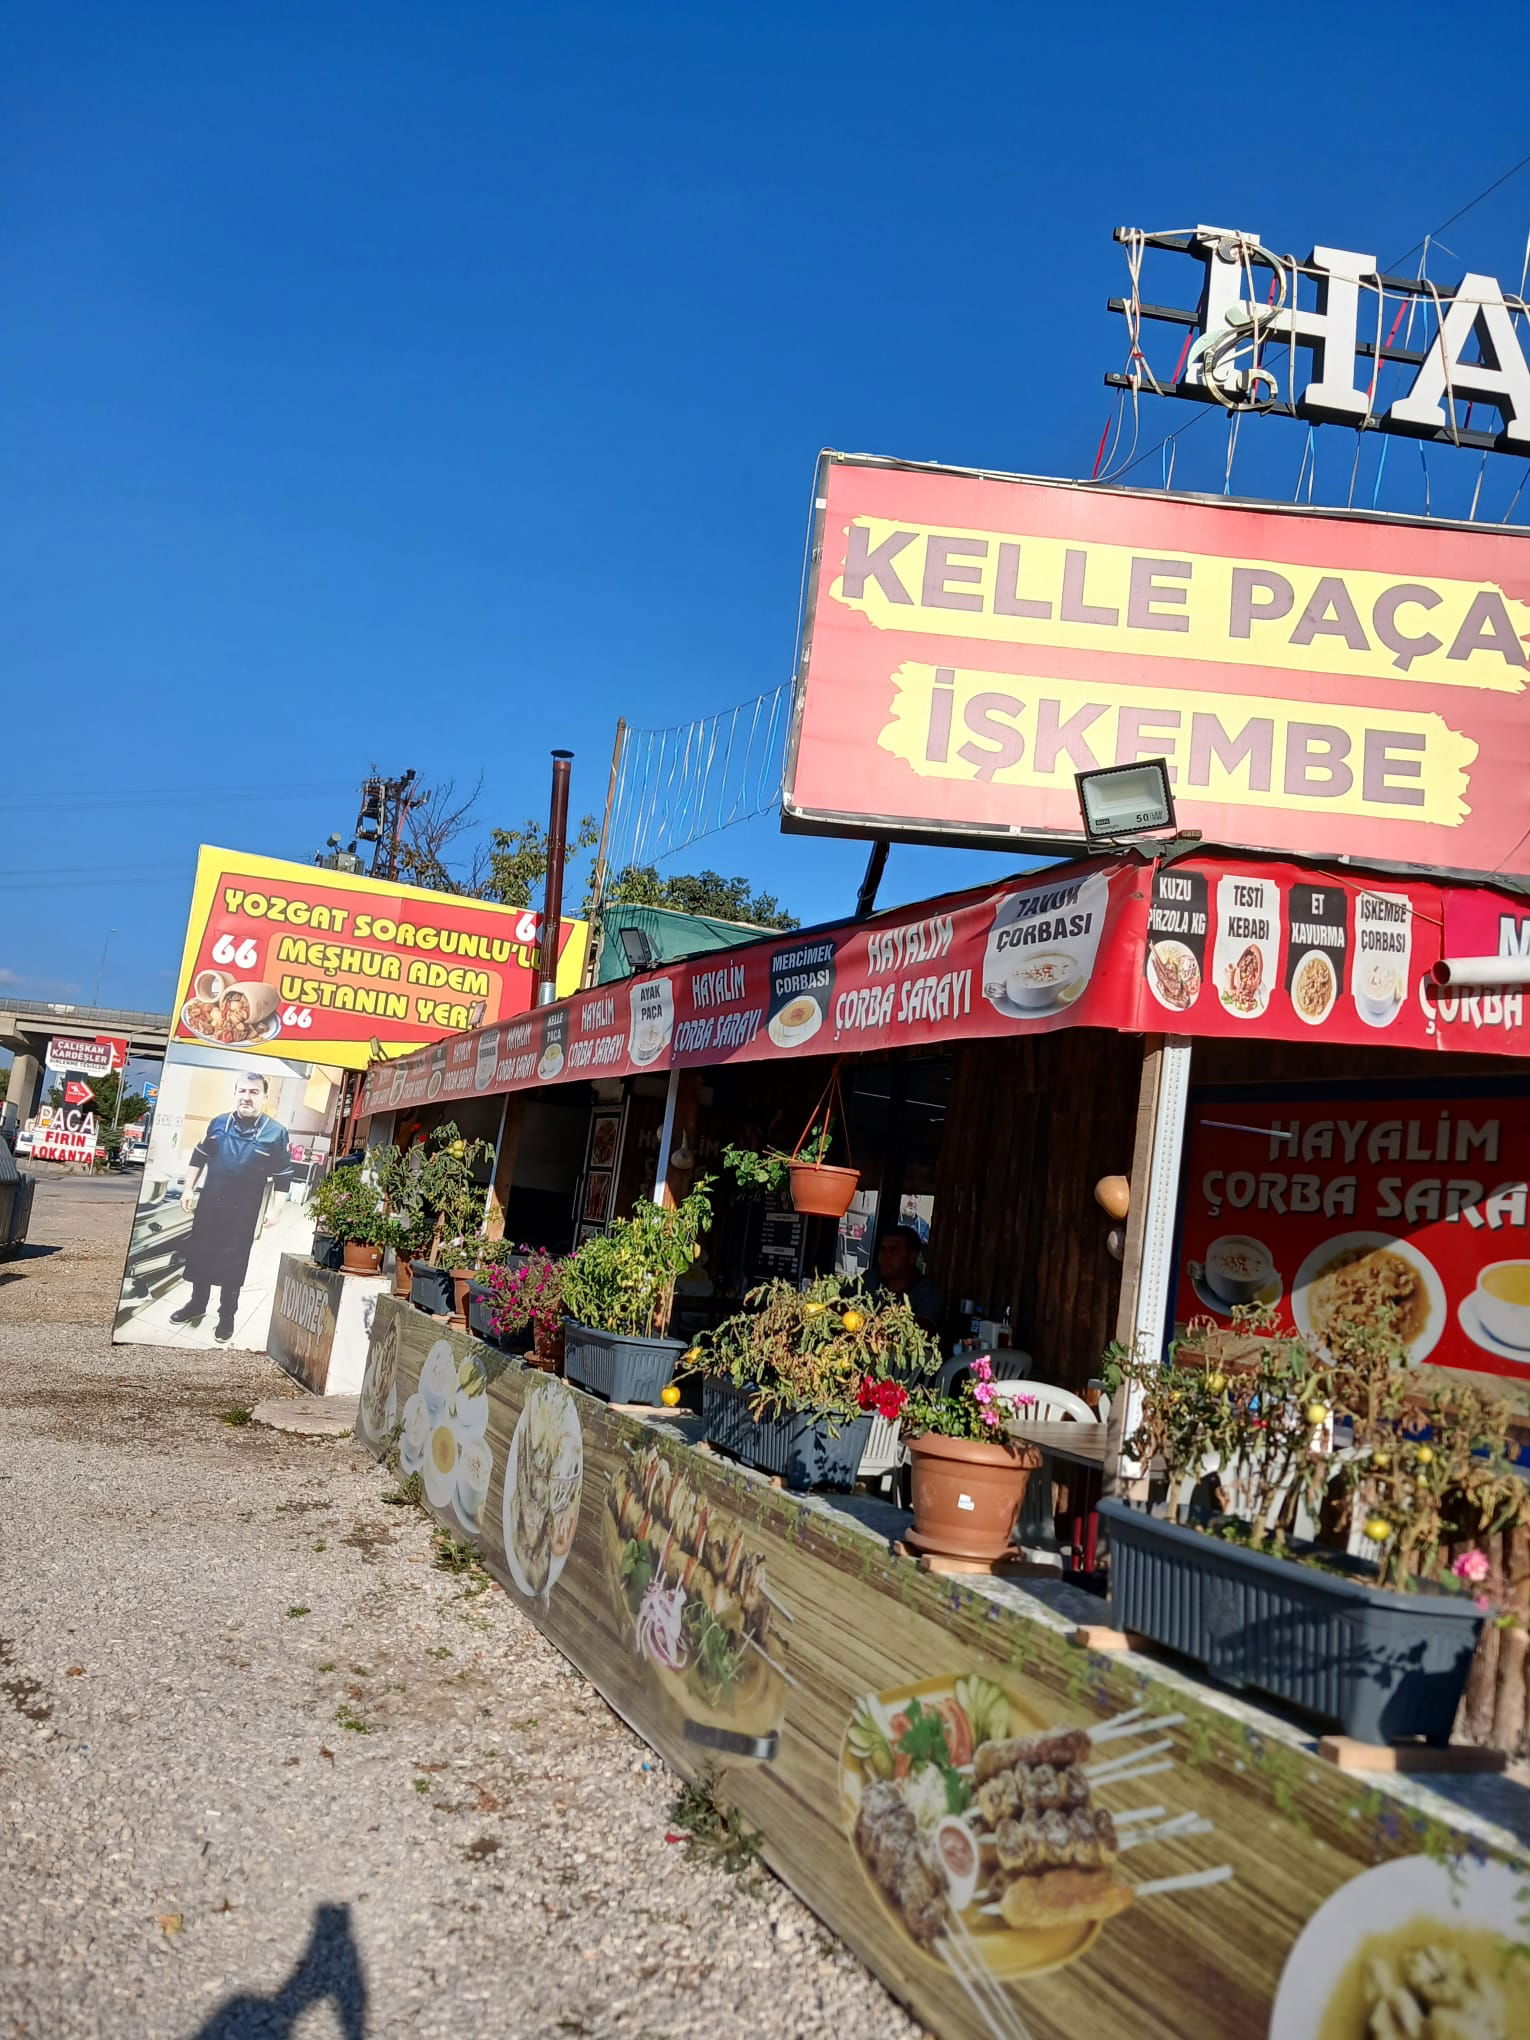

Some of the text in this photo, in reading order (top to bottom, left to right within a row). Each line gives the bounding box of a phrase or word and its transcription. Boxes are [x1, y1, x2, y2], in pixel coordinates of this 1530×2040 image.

[842, 525, 1529, 672] KELLE PAÇA
[924, 668, 1428, 808] İŞKEMBE
[1136, 813, 1149, 823] 50
[1016, 884, 1082, 919] TAVUK
[1159, 876, 1192, 901] KUZU
[1234, 883, 1264, 909] TESTİ
[1311, 893, 1325, 915] ET
[224, 888, 348, 935] YOZGAT
[1147, 904, 1206, 935] PİRZOLA KG
[1361, 894, 1407, 923] İŞKEMBE
[867, 912, 954, 977] HAYALİM
[996, 912, 1092, 953] ÇORBASI
[1228, 916, 1270, 941] KEBABI
[1291, 922, 1345, 948] KAVURMA
[1361, 929, 1406, 953] ÇORBASI
[212, 934, 257, 969] 66
[277, 937, 489, 997] MEŞHUR ADEM
[772, 944, 833, 972] MERCİMEK
[641, 984, 661, 1001] AYAK
[692, 959, 746, 1011] HAYALİM
[775, 969, 830, 997] ÇORBASI
[280, 975, 477, 1032] USTANIN YERİ
[282, 1005, 313, 1029] 66
[581, 992, 615, 1033] HAYALİM
[641, 1004, 662, 1021] PAÇA
[834, 969, 972, 1041] ÇORBA SARAYI
[1419, 971, 1523, 1035] ÇORBA
[671, 1008, 762, 1061] ÇORBA SARAYI
[51, 1048, 107, 1064] KARDEŞLER
[45, 1131, 87, 1147] FIRIN
[1269, 1110, 1500, 1165] HAYALİM
[31, 1145, 94, 1164] LOKANTA
[1202, 1170, 1529, 1231] ÇORBA SARA
[280, 1276, 329, 1345] KOKOREÇ
